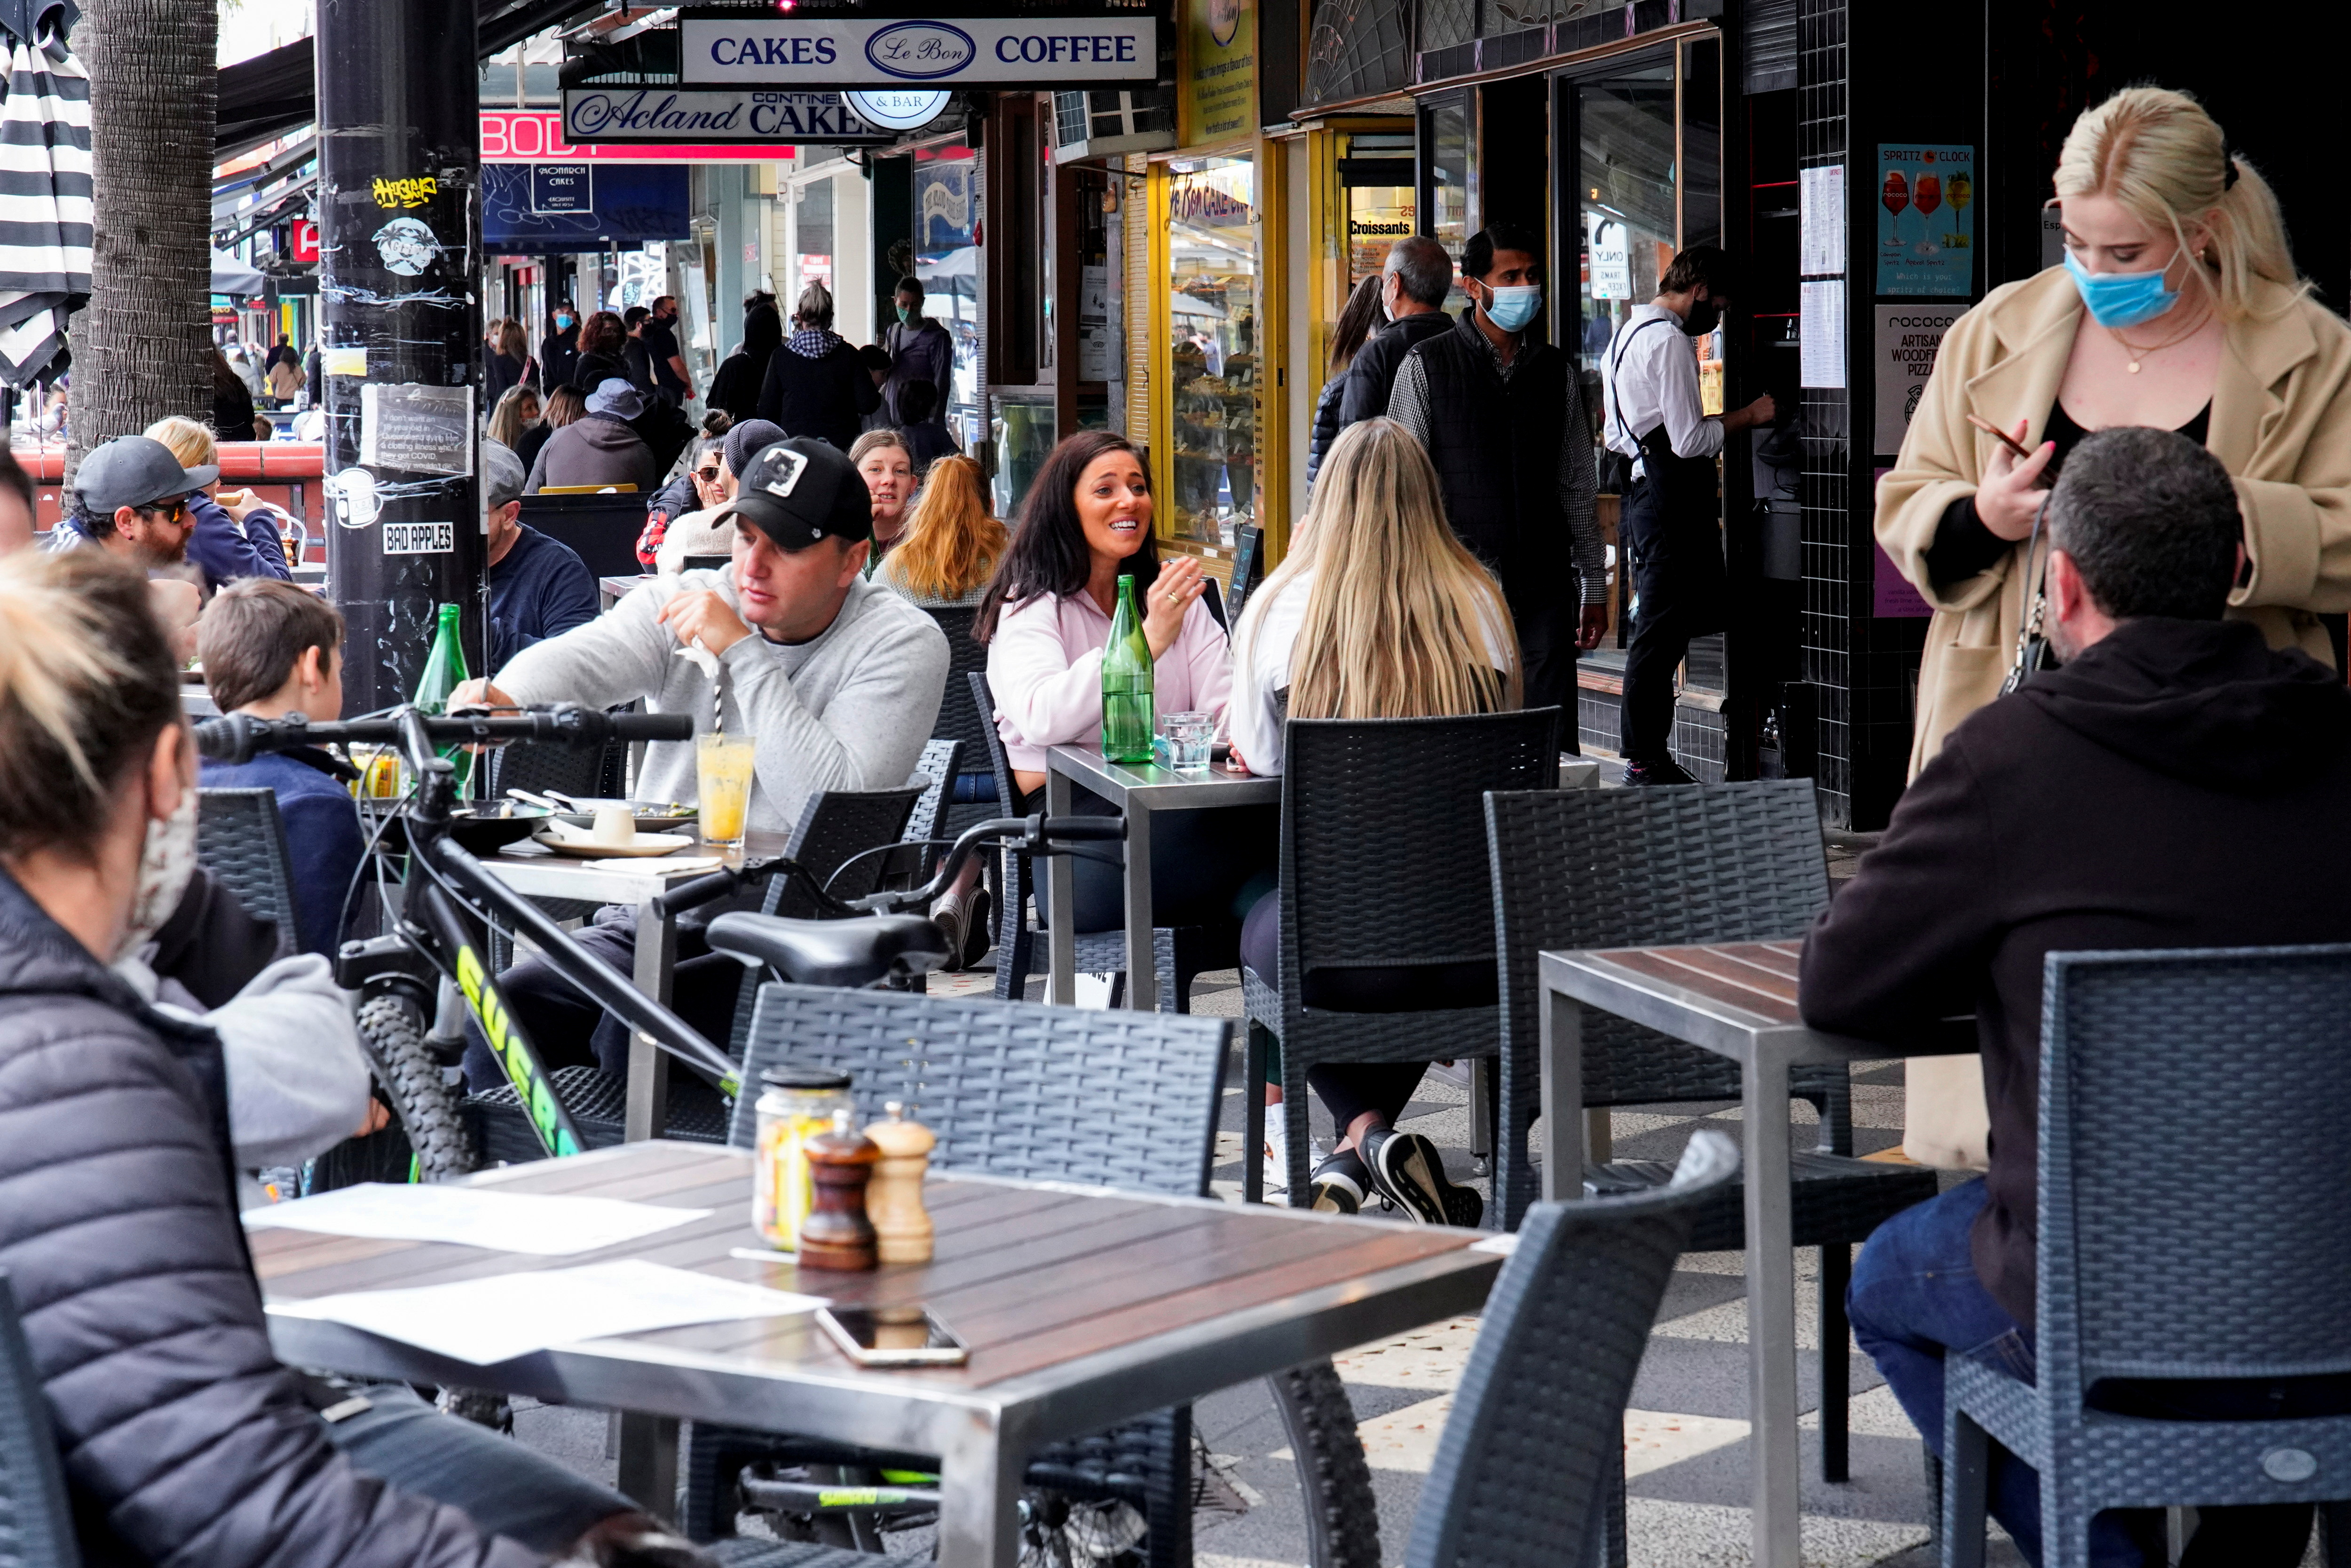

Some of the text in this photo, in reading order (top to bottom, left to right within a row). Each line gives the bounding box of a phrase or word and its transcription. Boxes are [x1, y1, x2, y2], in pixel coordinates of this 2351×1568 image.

[711, 38, 837, 65] CAKES
[882, 38, 964, 61] Le Bon
[995, 35, 1136, 63] COFFEE
[876, 95, 923, 107] & BAR
[571, 91, 743, 135] Acland
[750, 104, 873, 135] CAKE
[480, 117, 598, 156] BOD
[1884, 150, 1921, 162] SPRITZ
[538, 166, 585, 175] MONARCH
[549, 178, 575, 186] CAKES
[1349, 220, 1410, 235] Croissants
[1887, 286, 1913, 296] spritz
[1889, 317, 1955, 328] rococo
[387, 524, 451, 551] BAD APPLES
